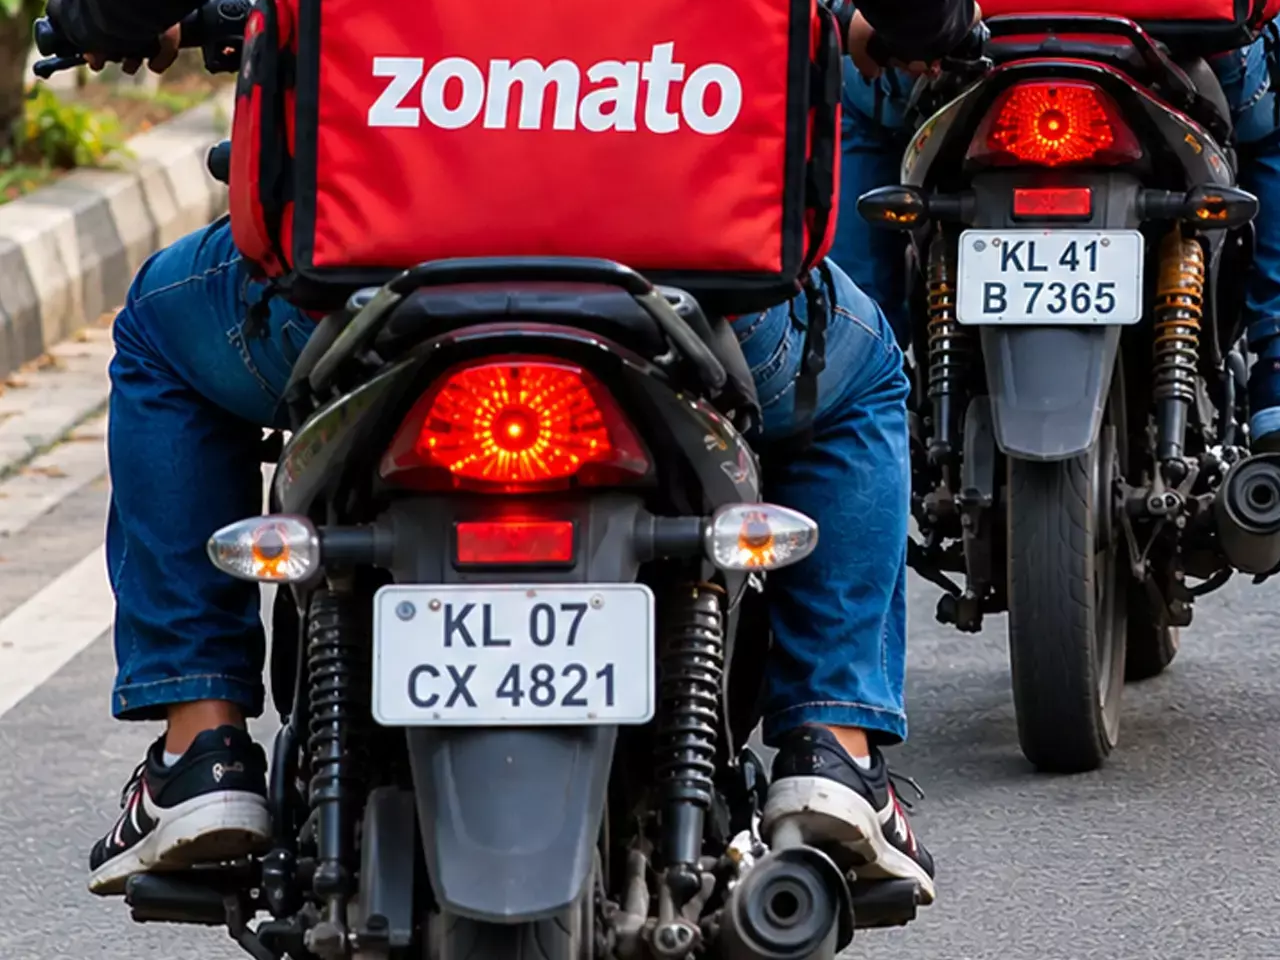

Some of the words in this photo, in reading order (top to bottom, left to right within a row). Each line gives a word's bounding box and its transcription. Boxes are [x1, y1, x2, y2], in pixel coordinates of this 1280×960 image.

[367, 41, 742, 135] zomato
[1001, 241, 1048, 272] KL
[1059, 241, 1097, 272] 41
[982, 282, 1007, 314] B
[1023, 282, 1116, 314] 7365
[443, 604, 512, 648] KL
[529, 602, 588, 648] 07
[407, 664, 477, 709] CX
[496, 663, 615, 708] 4821
